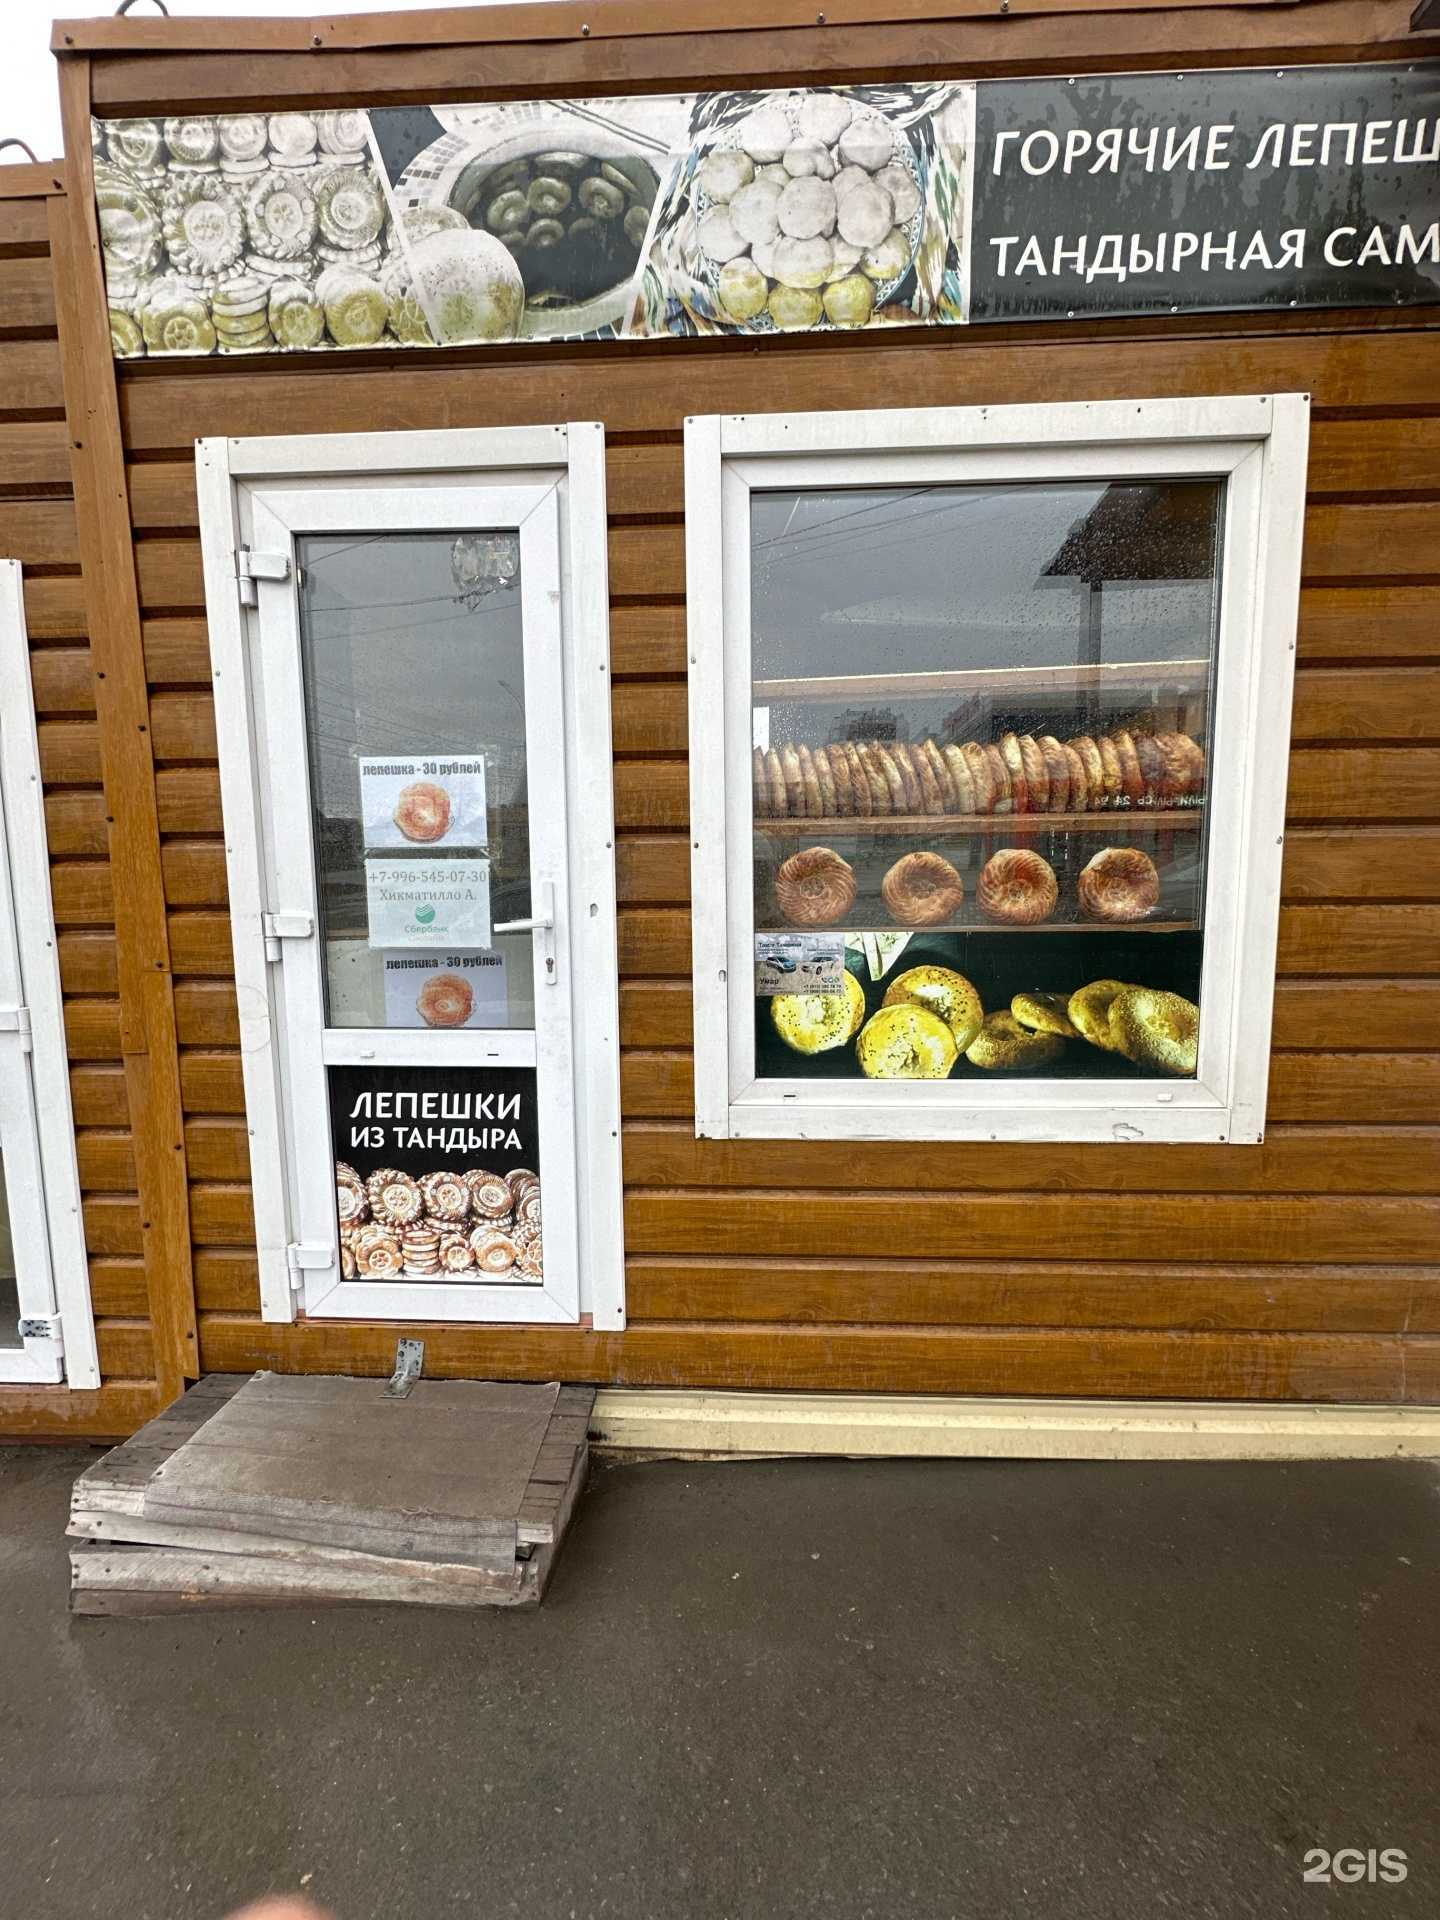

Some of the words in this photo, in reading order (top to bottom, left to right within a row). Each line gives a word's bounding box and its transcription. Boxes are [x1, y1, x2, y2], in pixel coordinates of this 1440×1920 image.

[992, 125, 1235, 177] ГОРЯЧИЕ
[1246, 118, 1440, 171] ЛЕПЕШ
[989, 228, 1306, 284] ТАНДЫРНАЯ
[1323, 222, 1440, 268] САМ
[363, 764, 415, 776] лепешка
[422, 762, 437, 775] 30
[439, 761, 481, 776] рублей
[369, 870, 487, 884] +7-996-545-07-30
[379, 889, 462, 902] Хикматилло
[386, 959, 439, 970] лепешка
[446, 956, 461, 968] 30
[350, 1092, 521, 1121] ЛЕПЕШКИ
[351, 1127, 385, 1149] ИЗ
[392, 1127, 522, 1154] ТАНДЫРА
